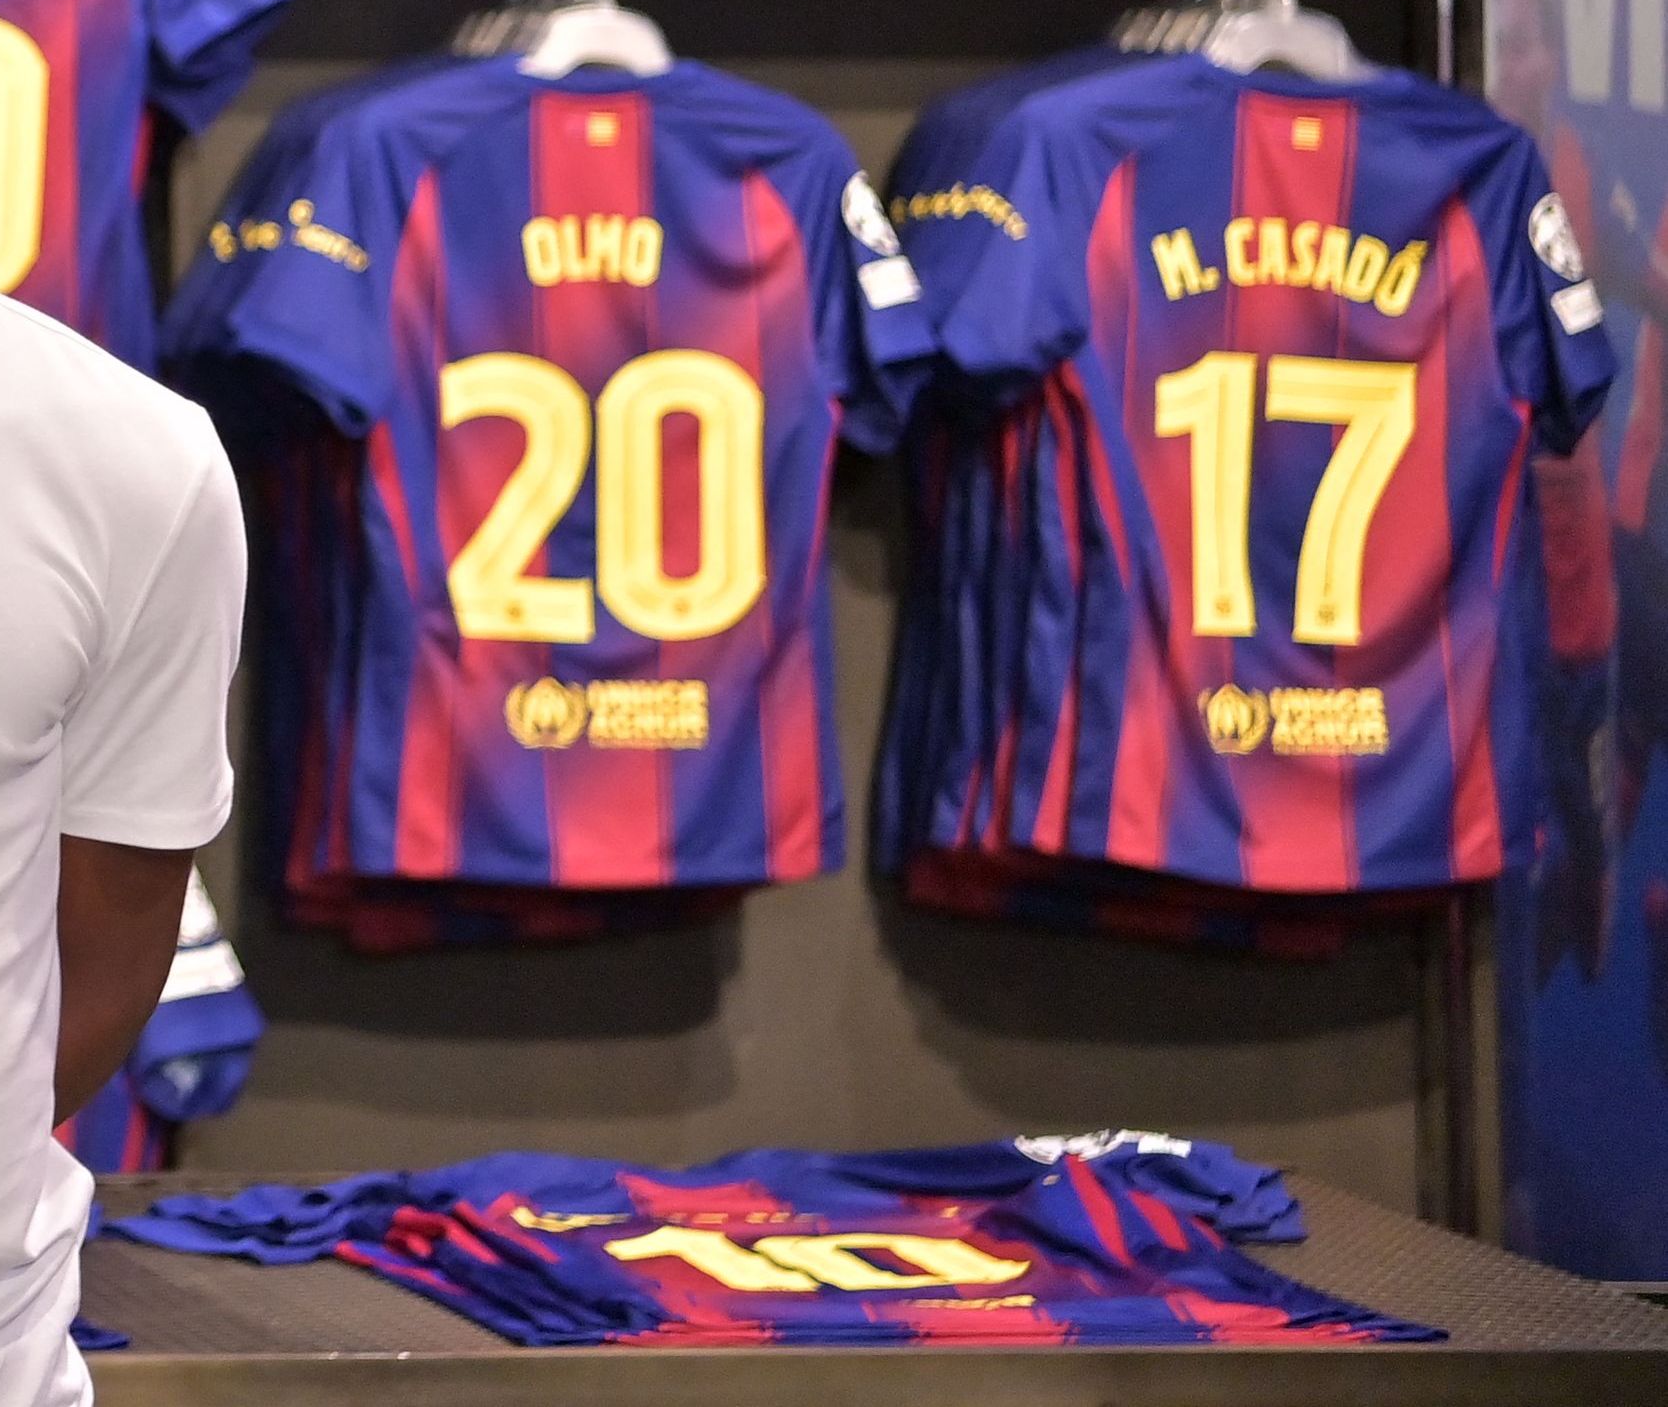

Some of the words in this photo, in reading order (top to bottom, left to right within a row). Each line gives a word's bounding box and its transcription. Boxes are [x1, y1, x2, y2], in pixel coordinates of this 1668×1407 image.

[522, 212, 664, 288] OLMO
[1152, 228, 1220, 301] M.
[1224, 216, 1428, 317] CASADÓ
[440, 348, 768, 644] 20
[1154, 350, 1418, 647] 17
[604, 1225, 1031, 1293] 10
